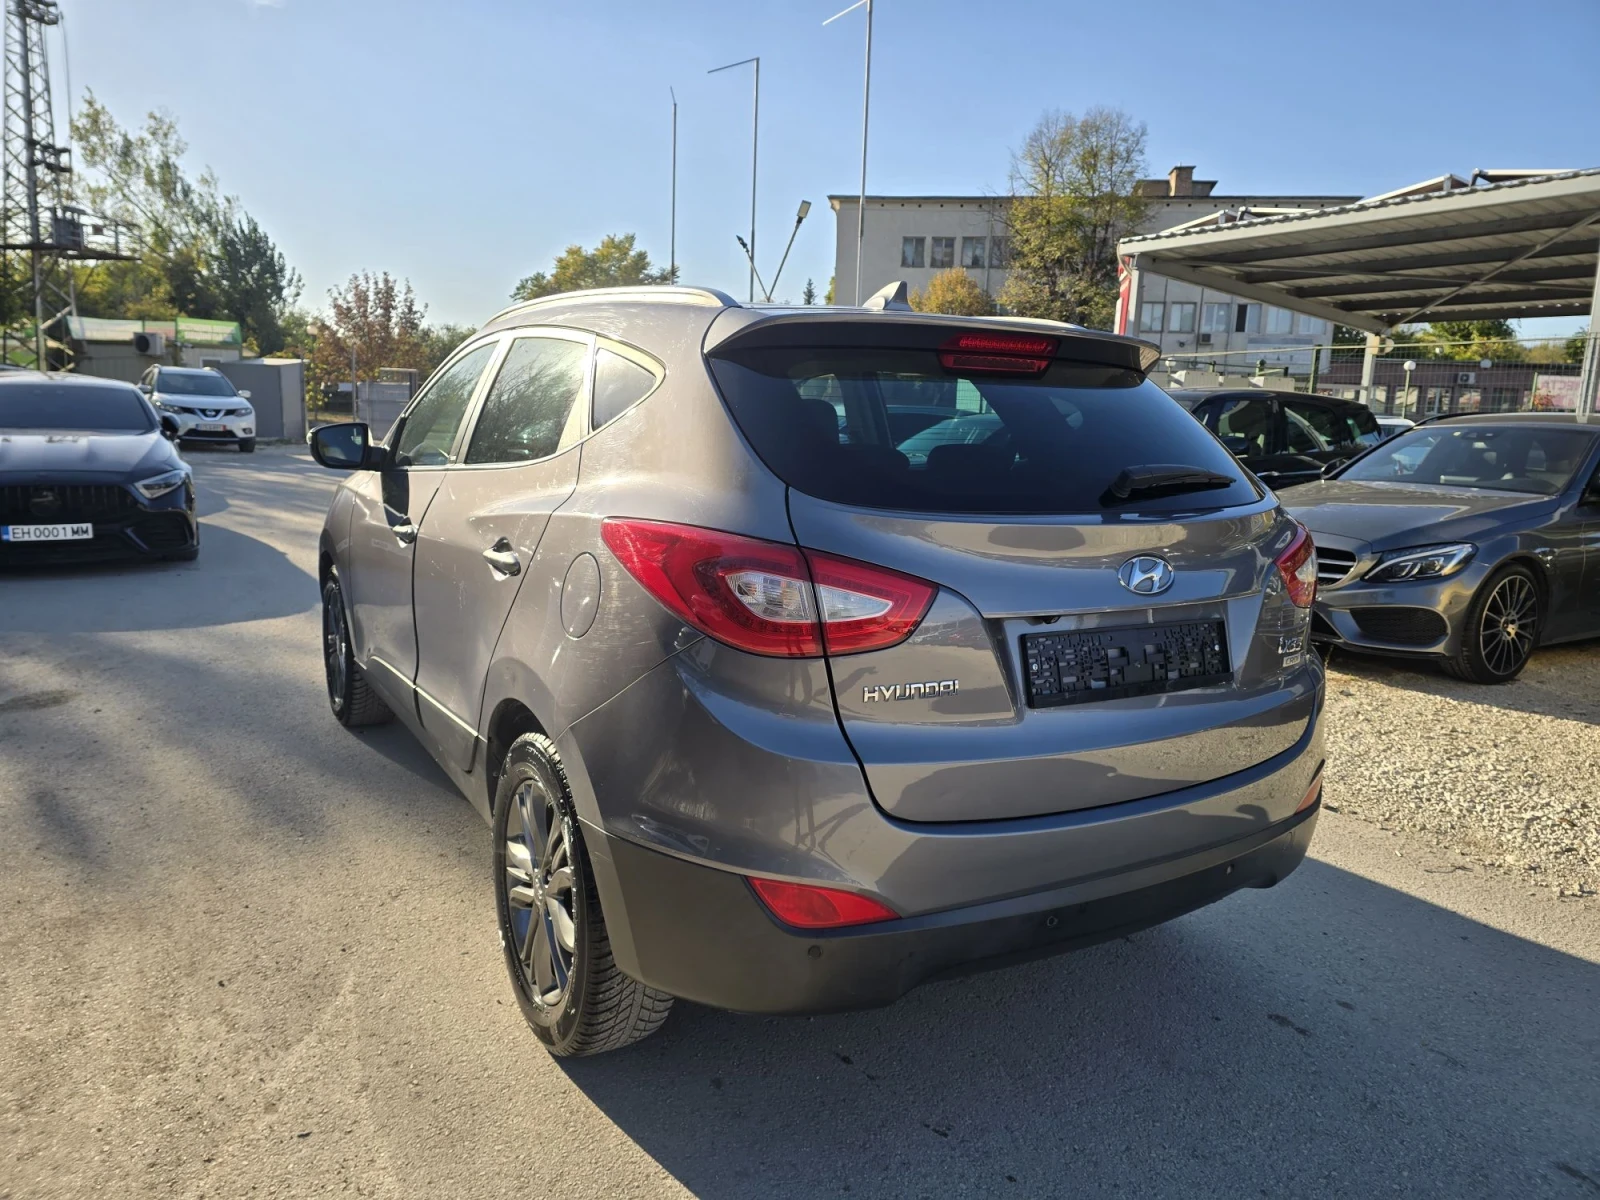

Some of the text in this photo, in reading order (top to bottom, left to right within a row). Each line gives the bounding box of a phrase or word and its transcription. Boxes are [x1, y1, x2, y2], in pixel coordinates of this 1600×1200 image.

[12, 526, 90, 539] EH 0001 MM
[863, 679, 960, 703] HYUNDAI
